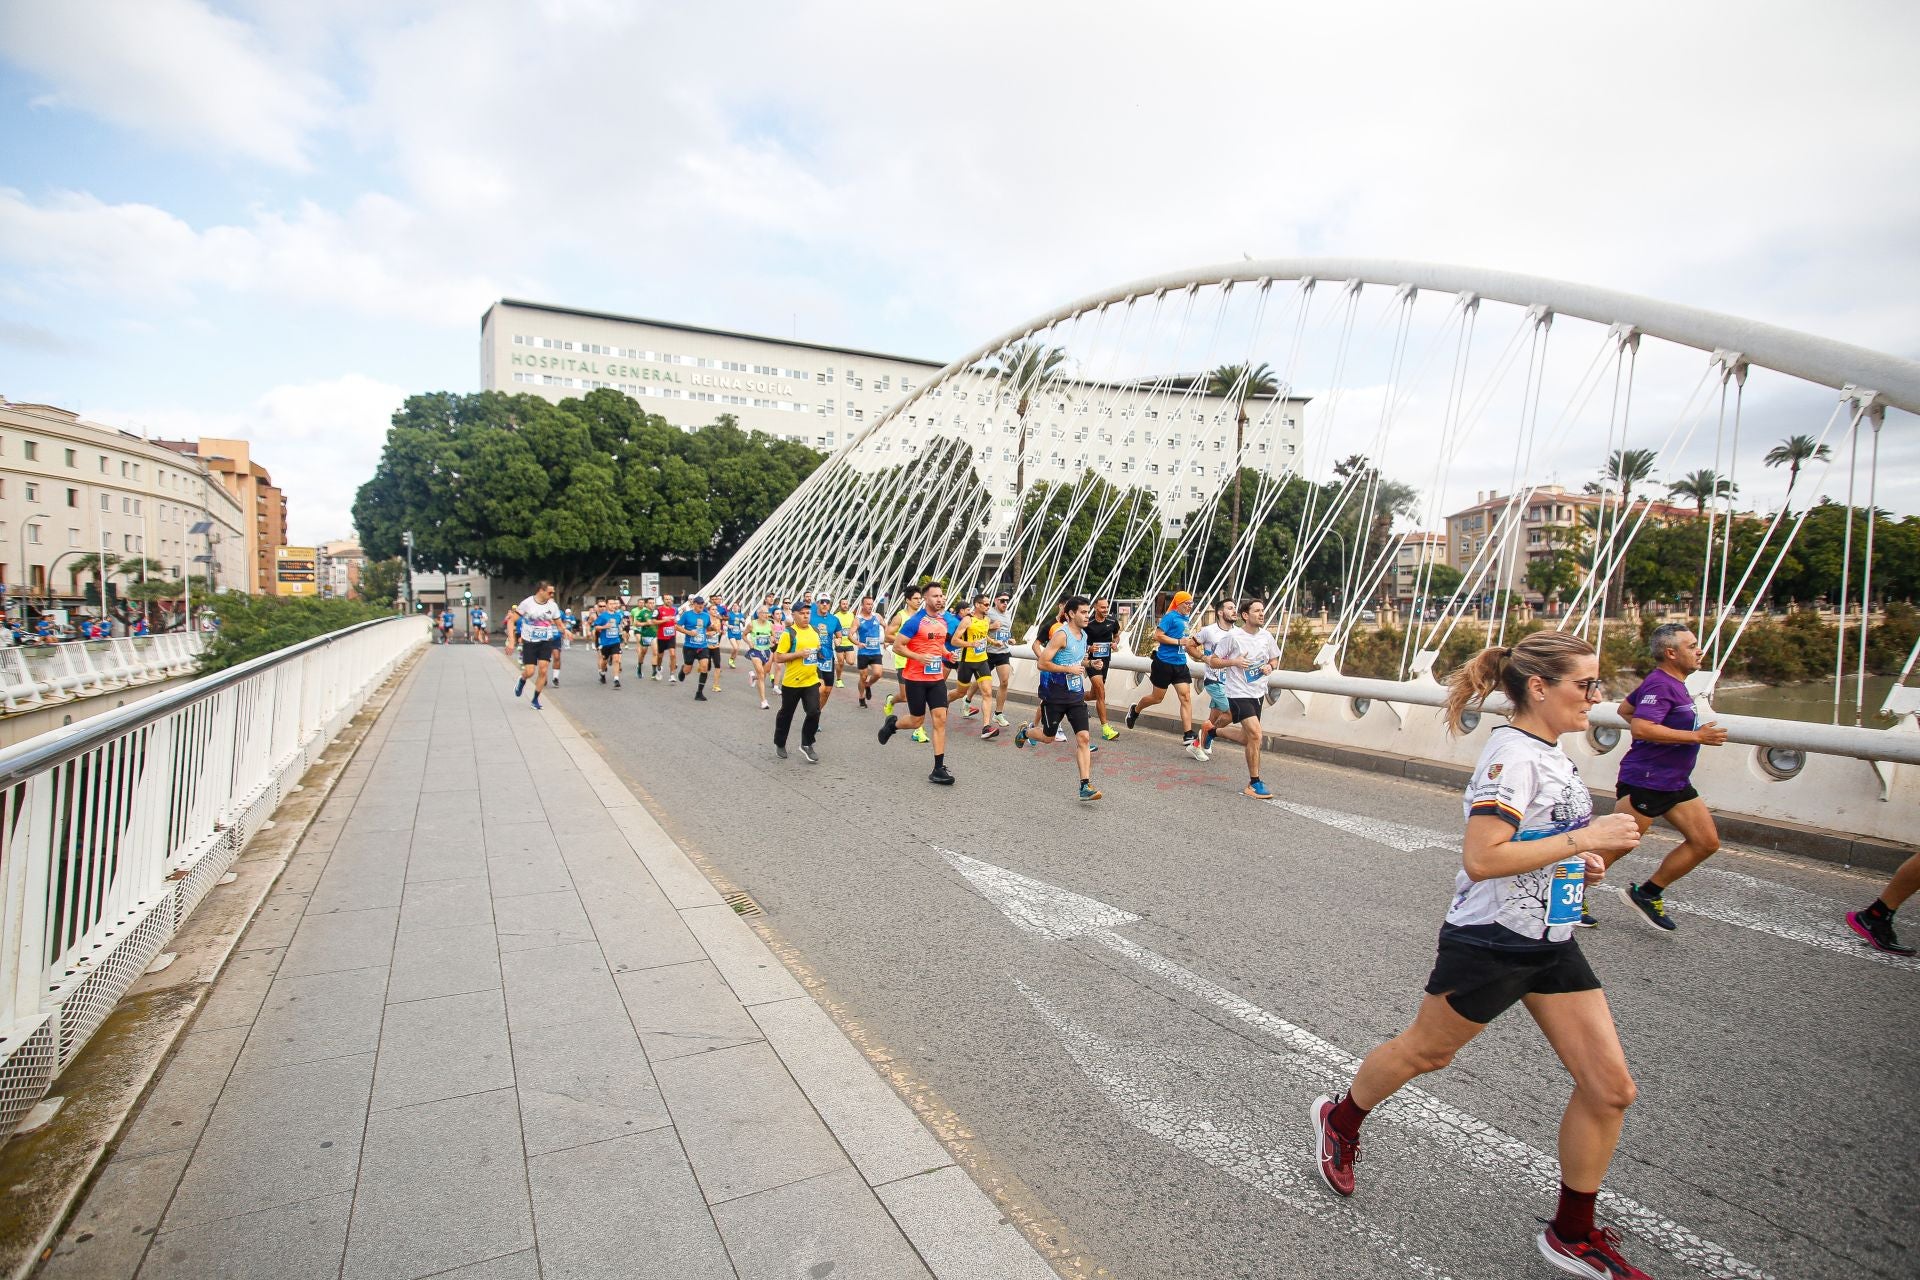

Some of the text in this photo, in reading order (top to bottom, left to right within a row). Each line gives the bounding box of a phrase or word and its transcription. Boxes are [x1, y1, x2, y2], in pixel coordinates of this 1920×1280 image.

[511, 352, 599, 375] HOSPITAL
[606, 363, 682, 384] GENERAL
[691, 373, 742, 391] REINA
